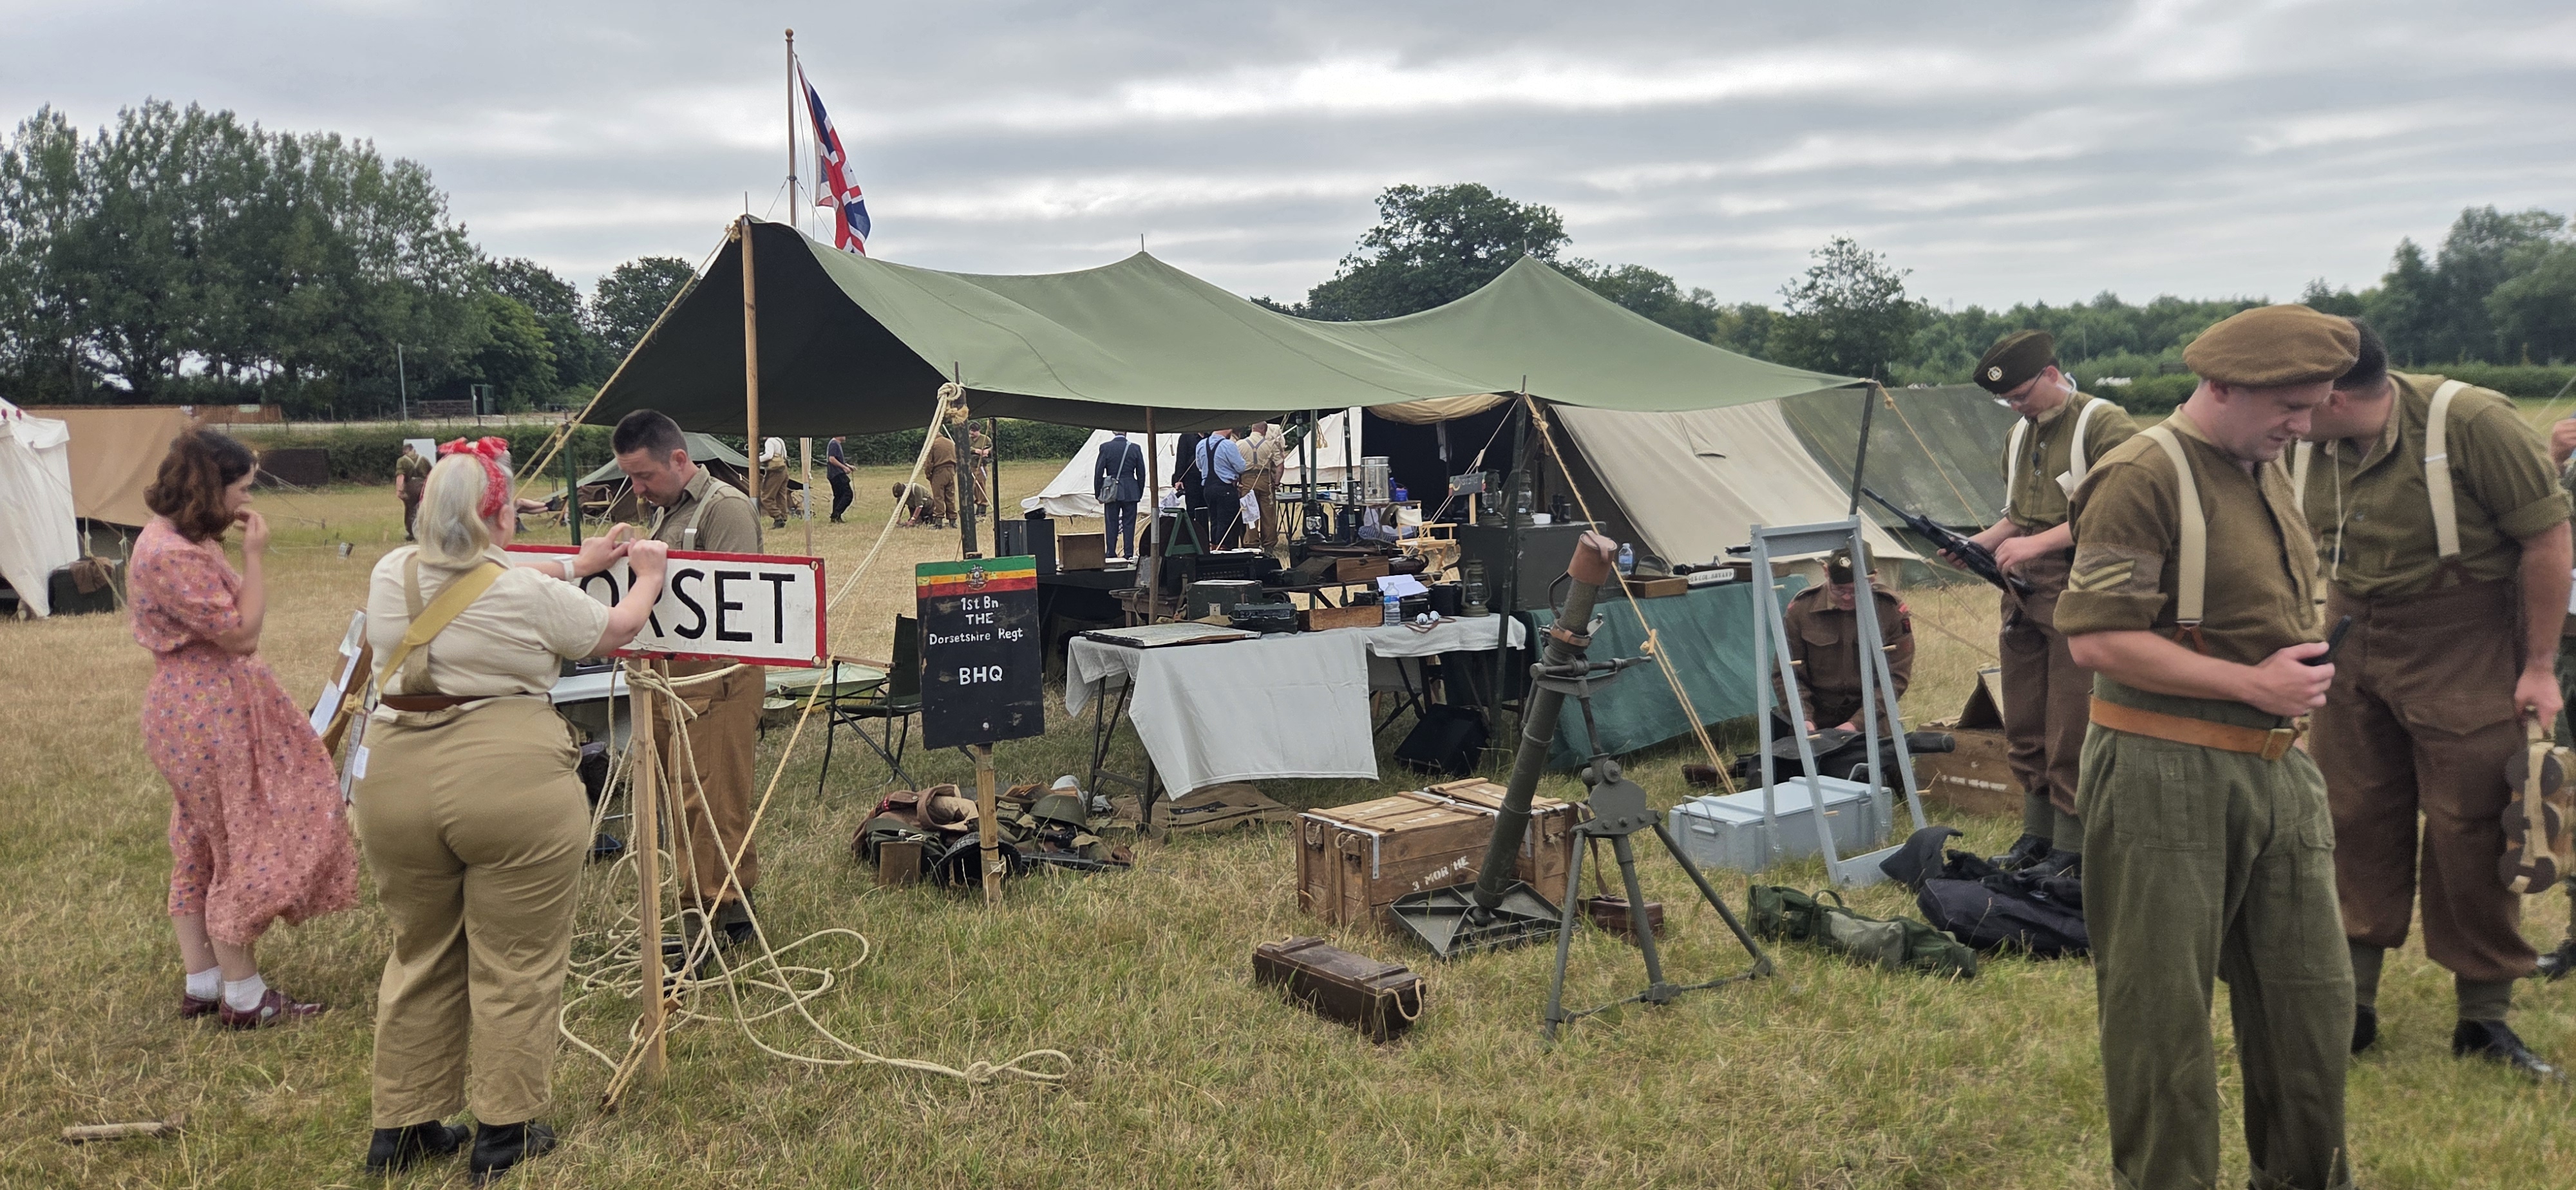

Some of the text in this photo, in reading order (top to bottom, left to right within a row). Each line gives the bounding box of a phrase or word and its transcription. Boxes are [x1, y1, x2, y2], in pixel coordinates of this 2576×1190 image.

[579, 564, 795, 643] ORSET
[960, 596, 998, 610] 1st Bn
[965, 612, 994, 625] THE
[929, 627, 1023, 645] Dorsetshire Regt
[959, 665, 1003, 685] BHQ
[1412, 881, 1419, 891] 3
[1424, 866, 1449, 885] MOR
